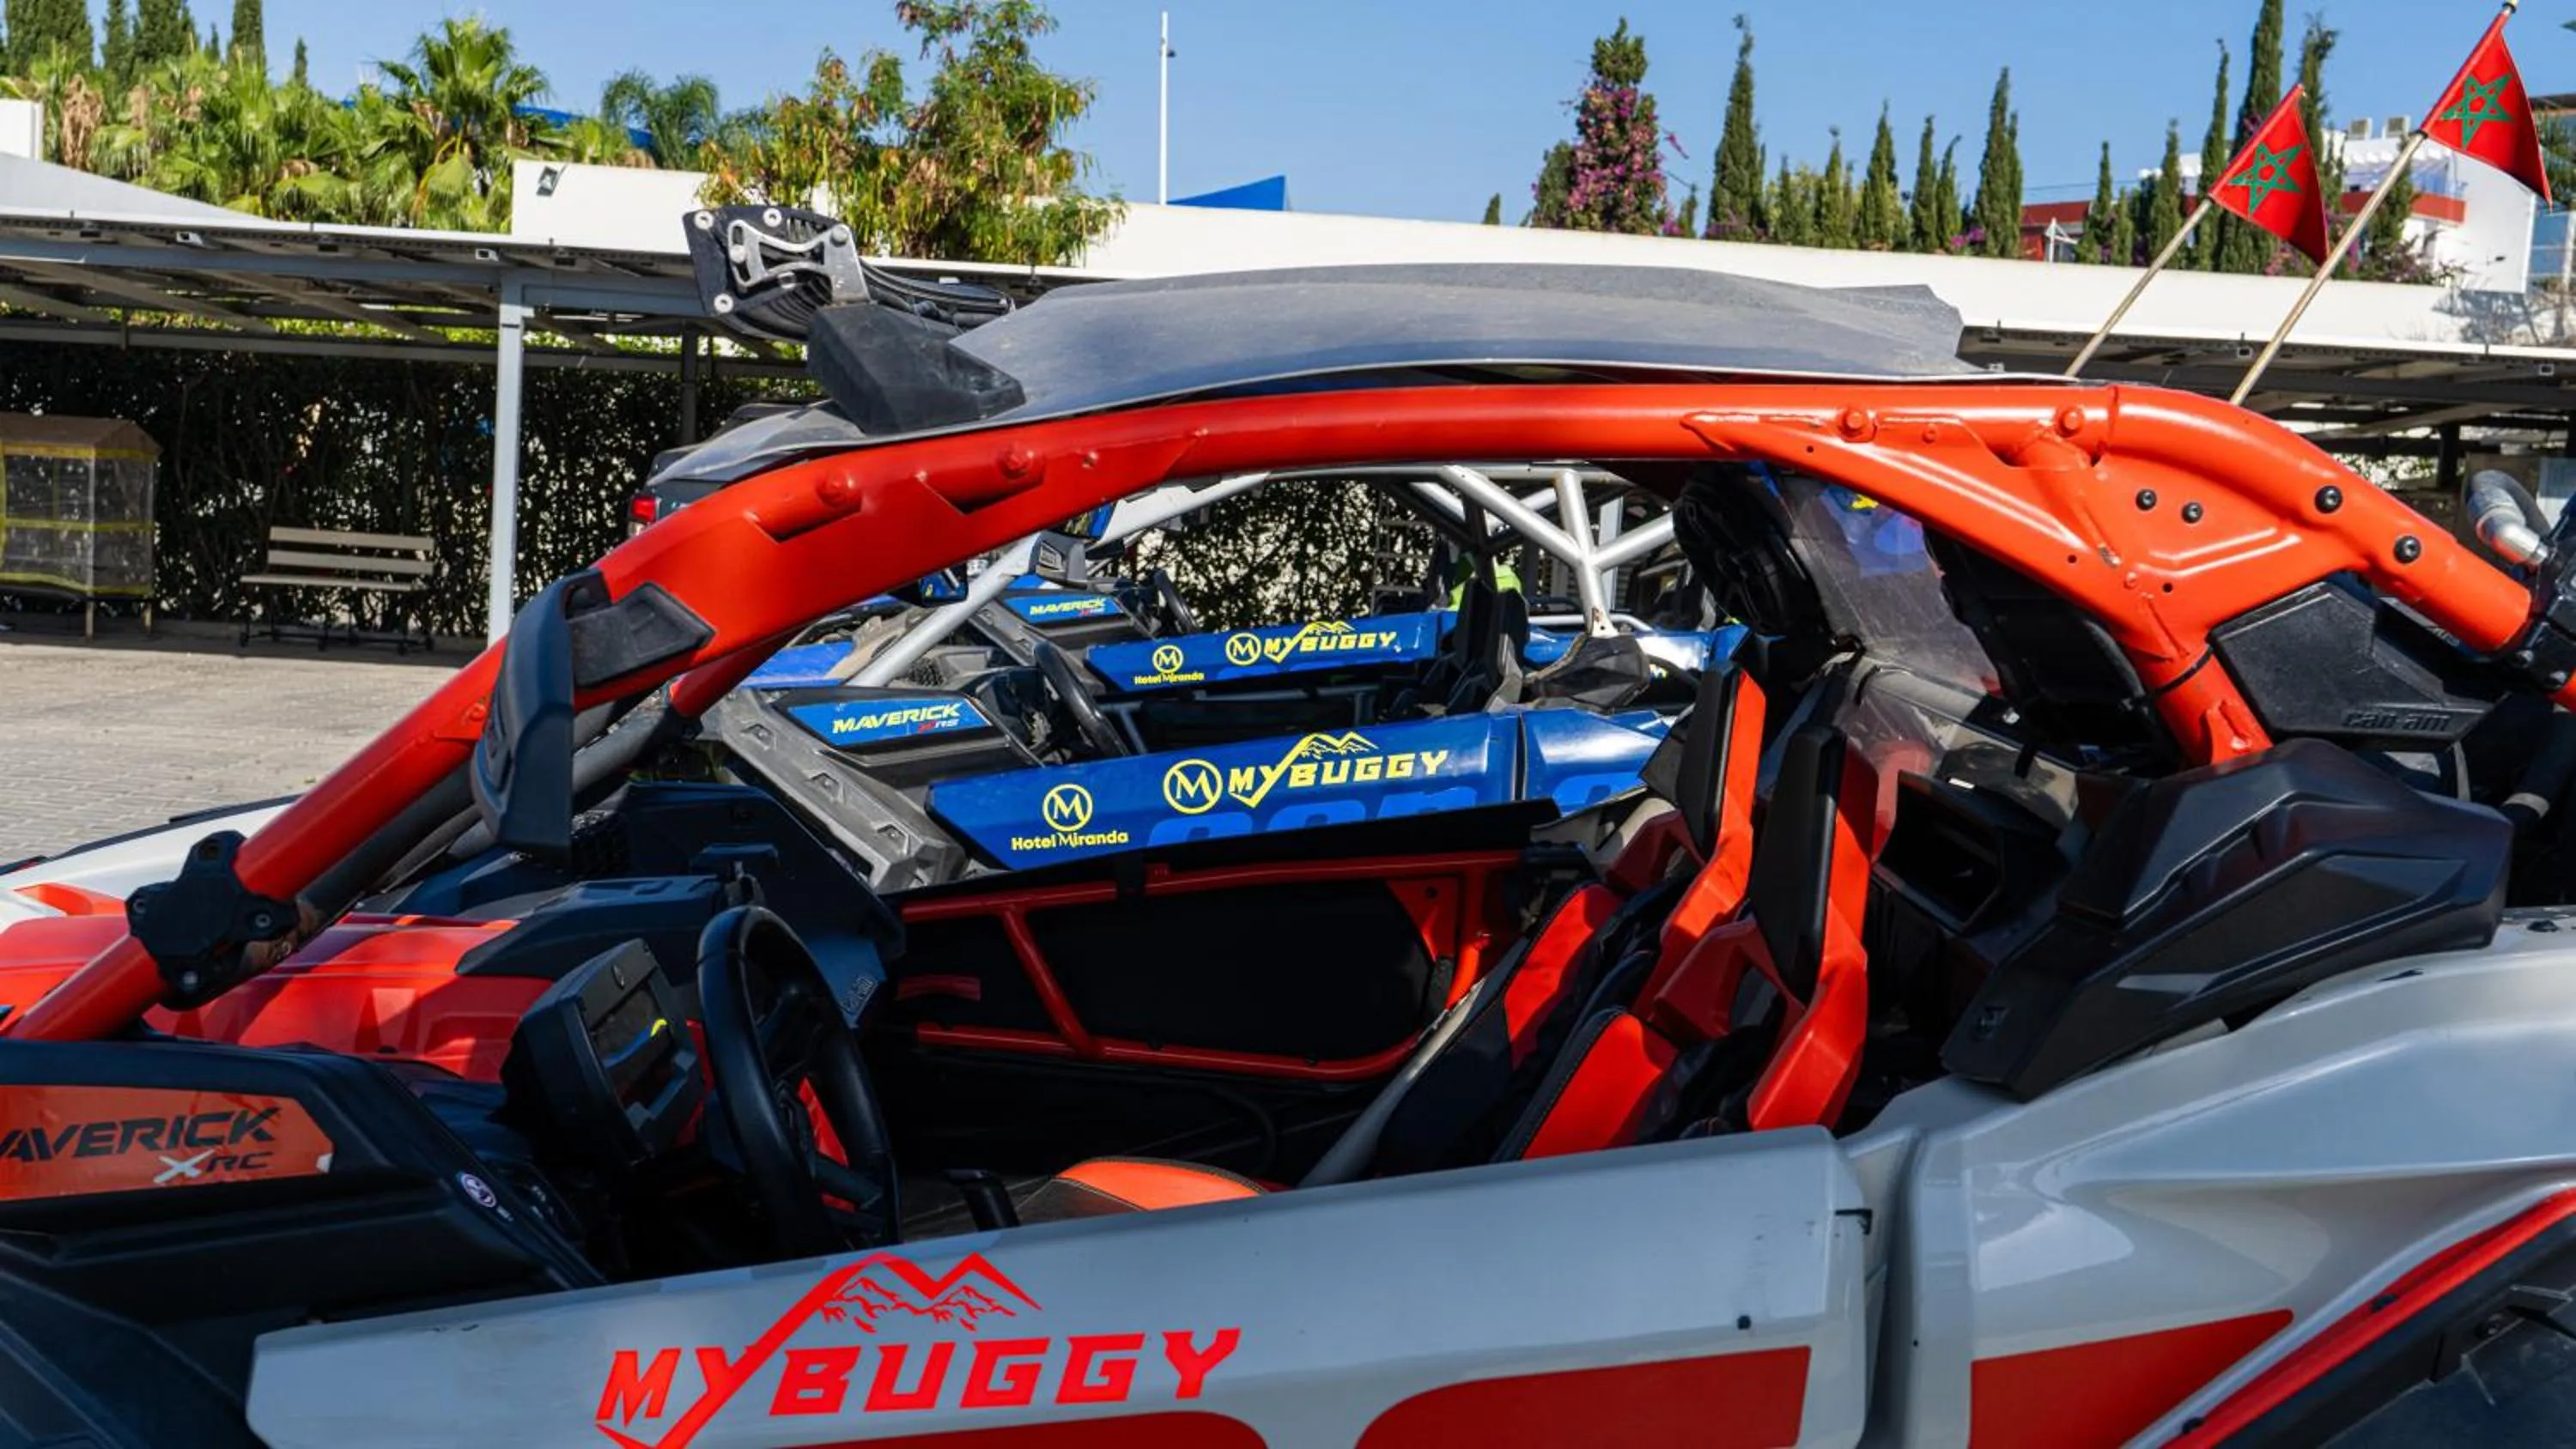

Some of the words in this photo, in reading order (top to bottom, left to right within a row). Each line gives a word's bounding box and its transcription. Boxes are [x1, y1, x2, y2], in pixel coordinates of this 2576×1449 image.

[832, 702, 963, 733] MAVERICK
[1011, 833, 1057, 850] Hotel
[1058, 829, 1129, 848] Miranda
